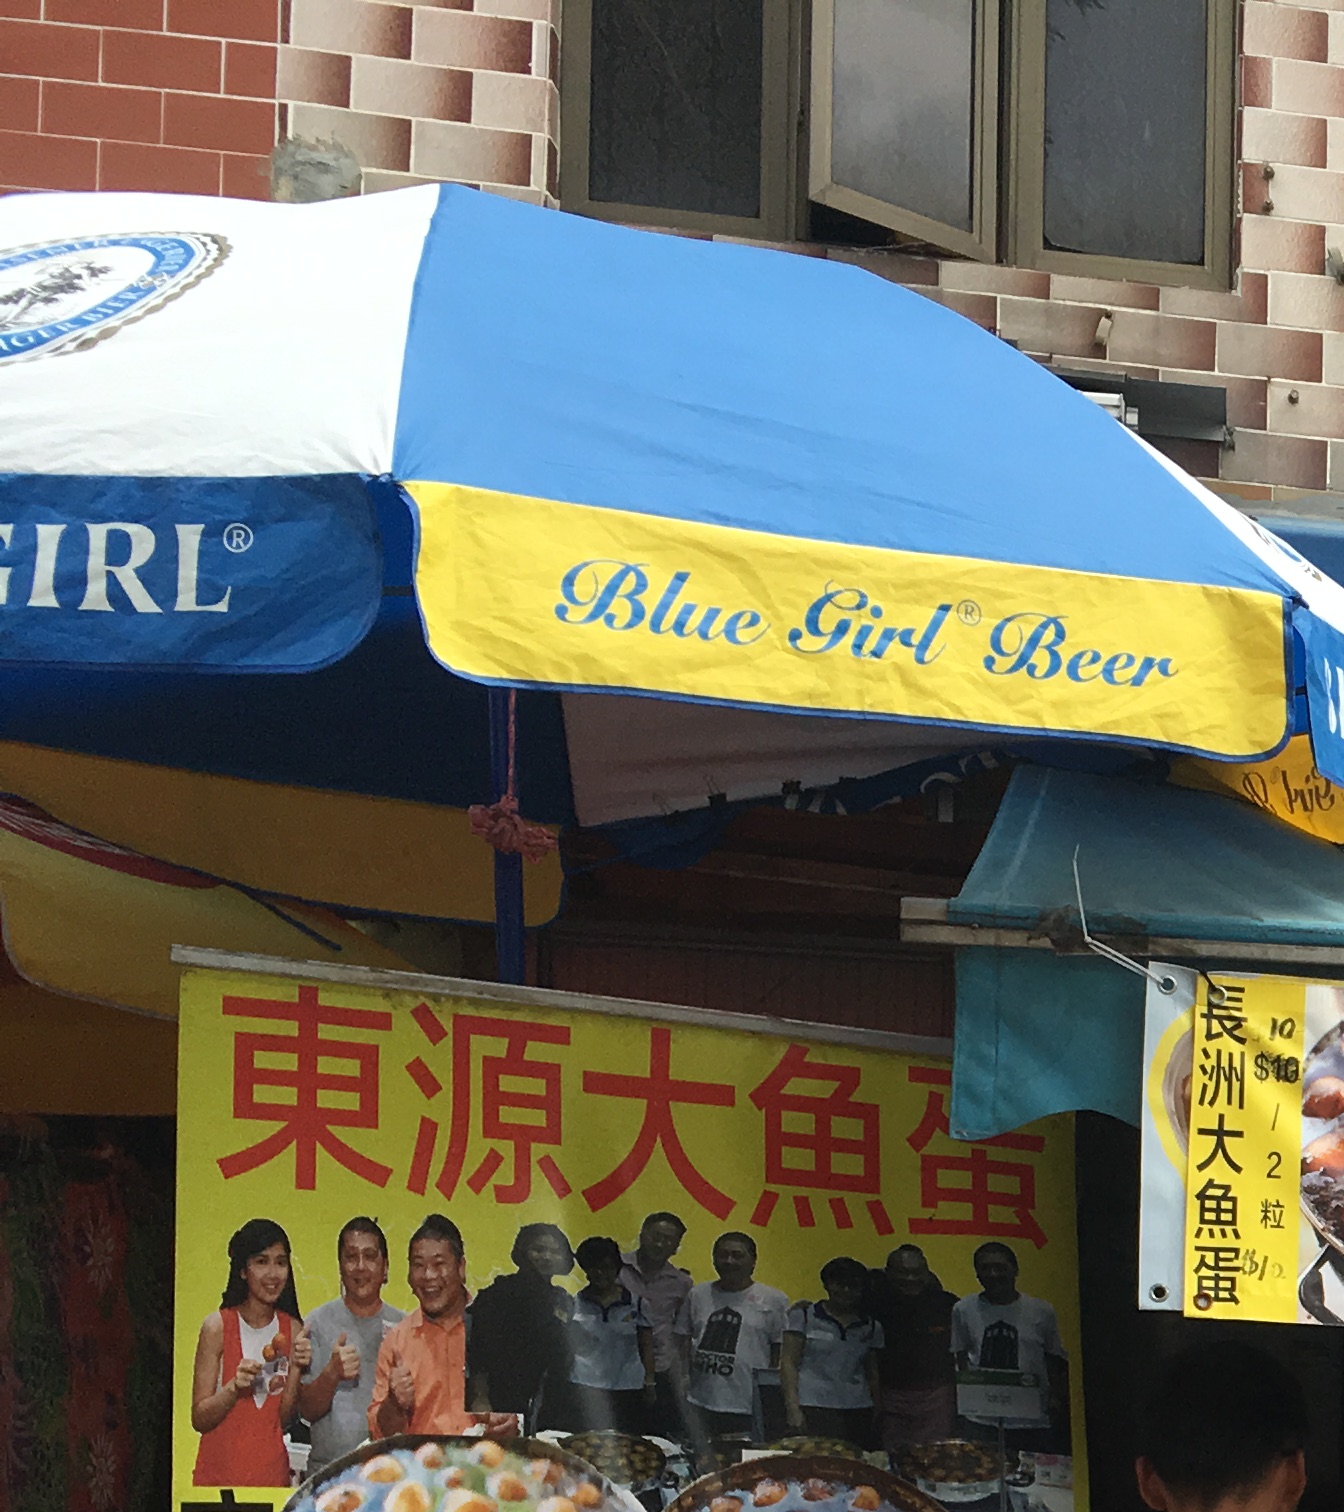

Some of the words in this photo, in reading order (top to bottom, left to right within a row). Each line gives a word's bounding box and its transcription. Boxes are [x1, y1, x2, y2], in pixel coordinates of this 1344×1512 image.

[554, 558, 770, 647] Blue
[982, 612, 1180, 689] Beer
[215, 984, 1052, 1253] 東源大魚蛋
[1194, 984, 1249, 1307] 長洲大魚蛋
